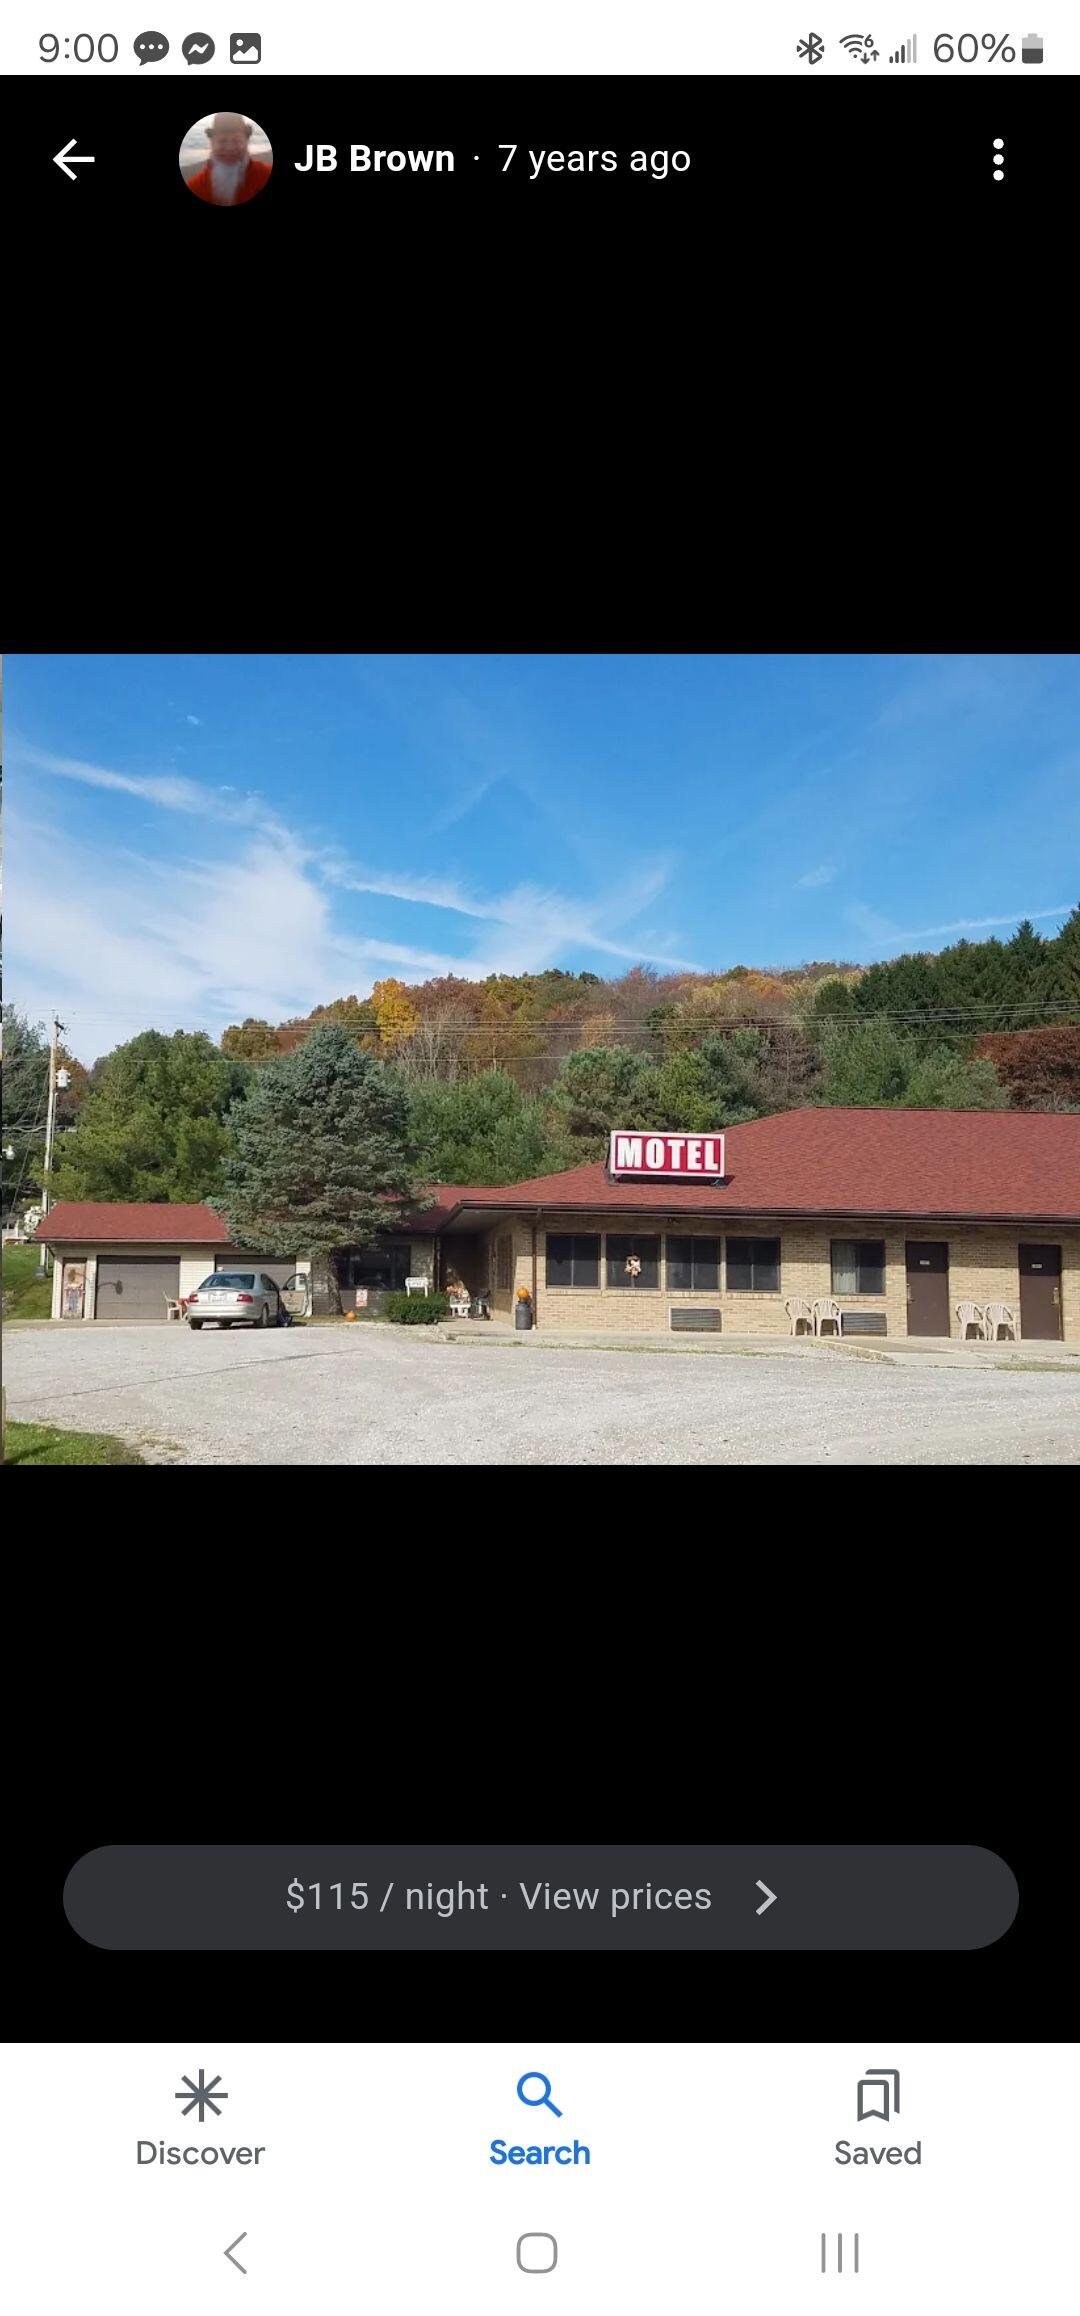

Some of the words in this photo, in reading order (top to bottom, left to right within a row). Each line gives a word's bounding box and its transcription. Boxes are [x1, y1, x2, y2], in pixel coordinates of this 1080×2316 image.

[38, 33, 119, 64] 9:00
[933, 33, 1017, 64] 60%
[293, 144, 338, 172] JB
[350, 144, 455, 172] Brown
[497, 144, 518, 172] 7
[528, 150, 618, 180] years
[629, 150, 691, 180] ago
[617, 1137, 719, 1171] MOTEL
[286, 1878, 369, 1914] $115
[379, 1882, 395, 1913] /
[406, 1880, 489, 1918] night
[519, 1882, 600, 1910] View
[611, 1882, 712, 1918] prices
[136, 2140, 266, 2166] Discover
[489, 2138, 591, 2166] Search
[834, 2139, 922, 2166] Saved
